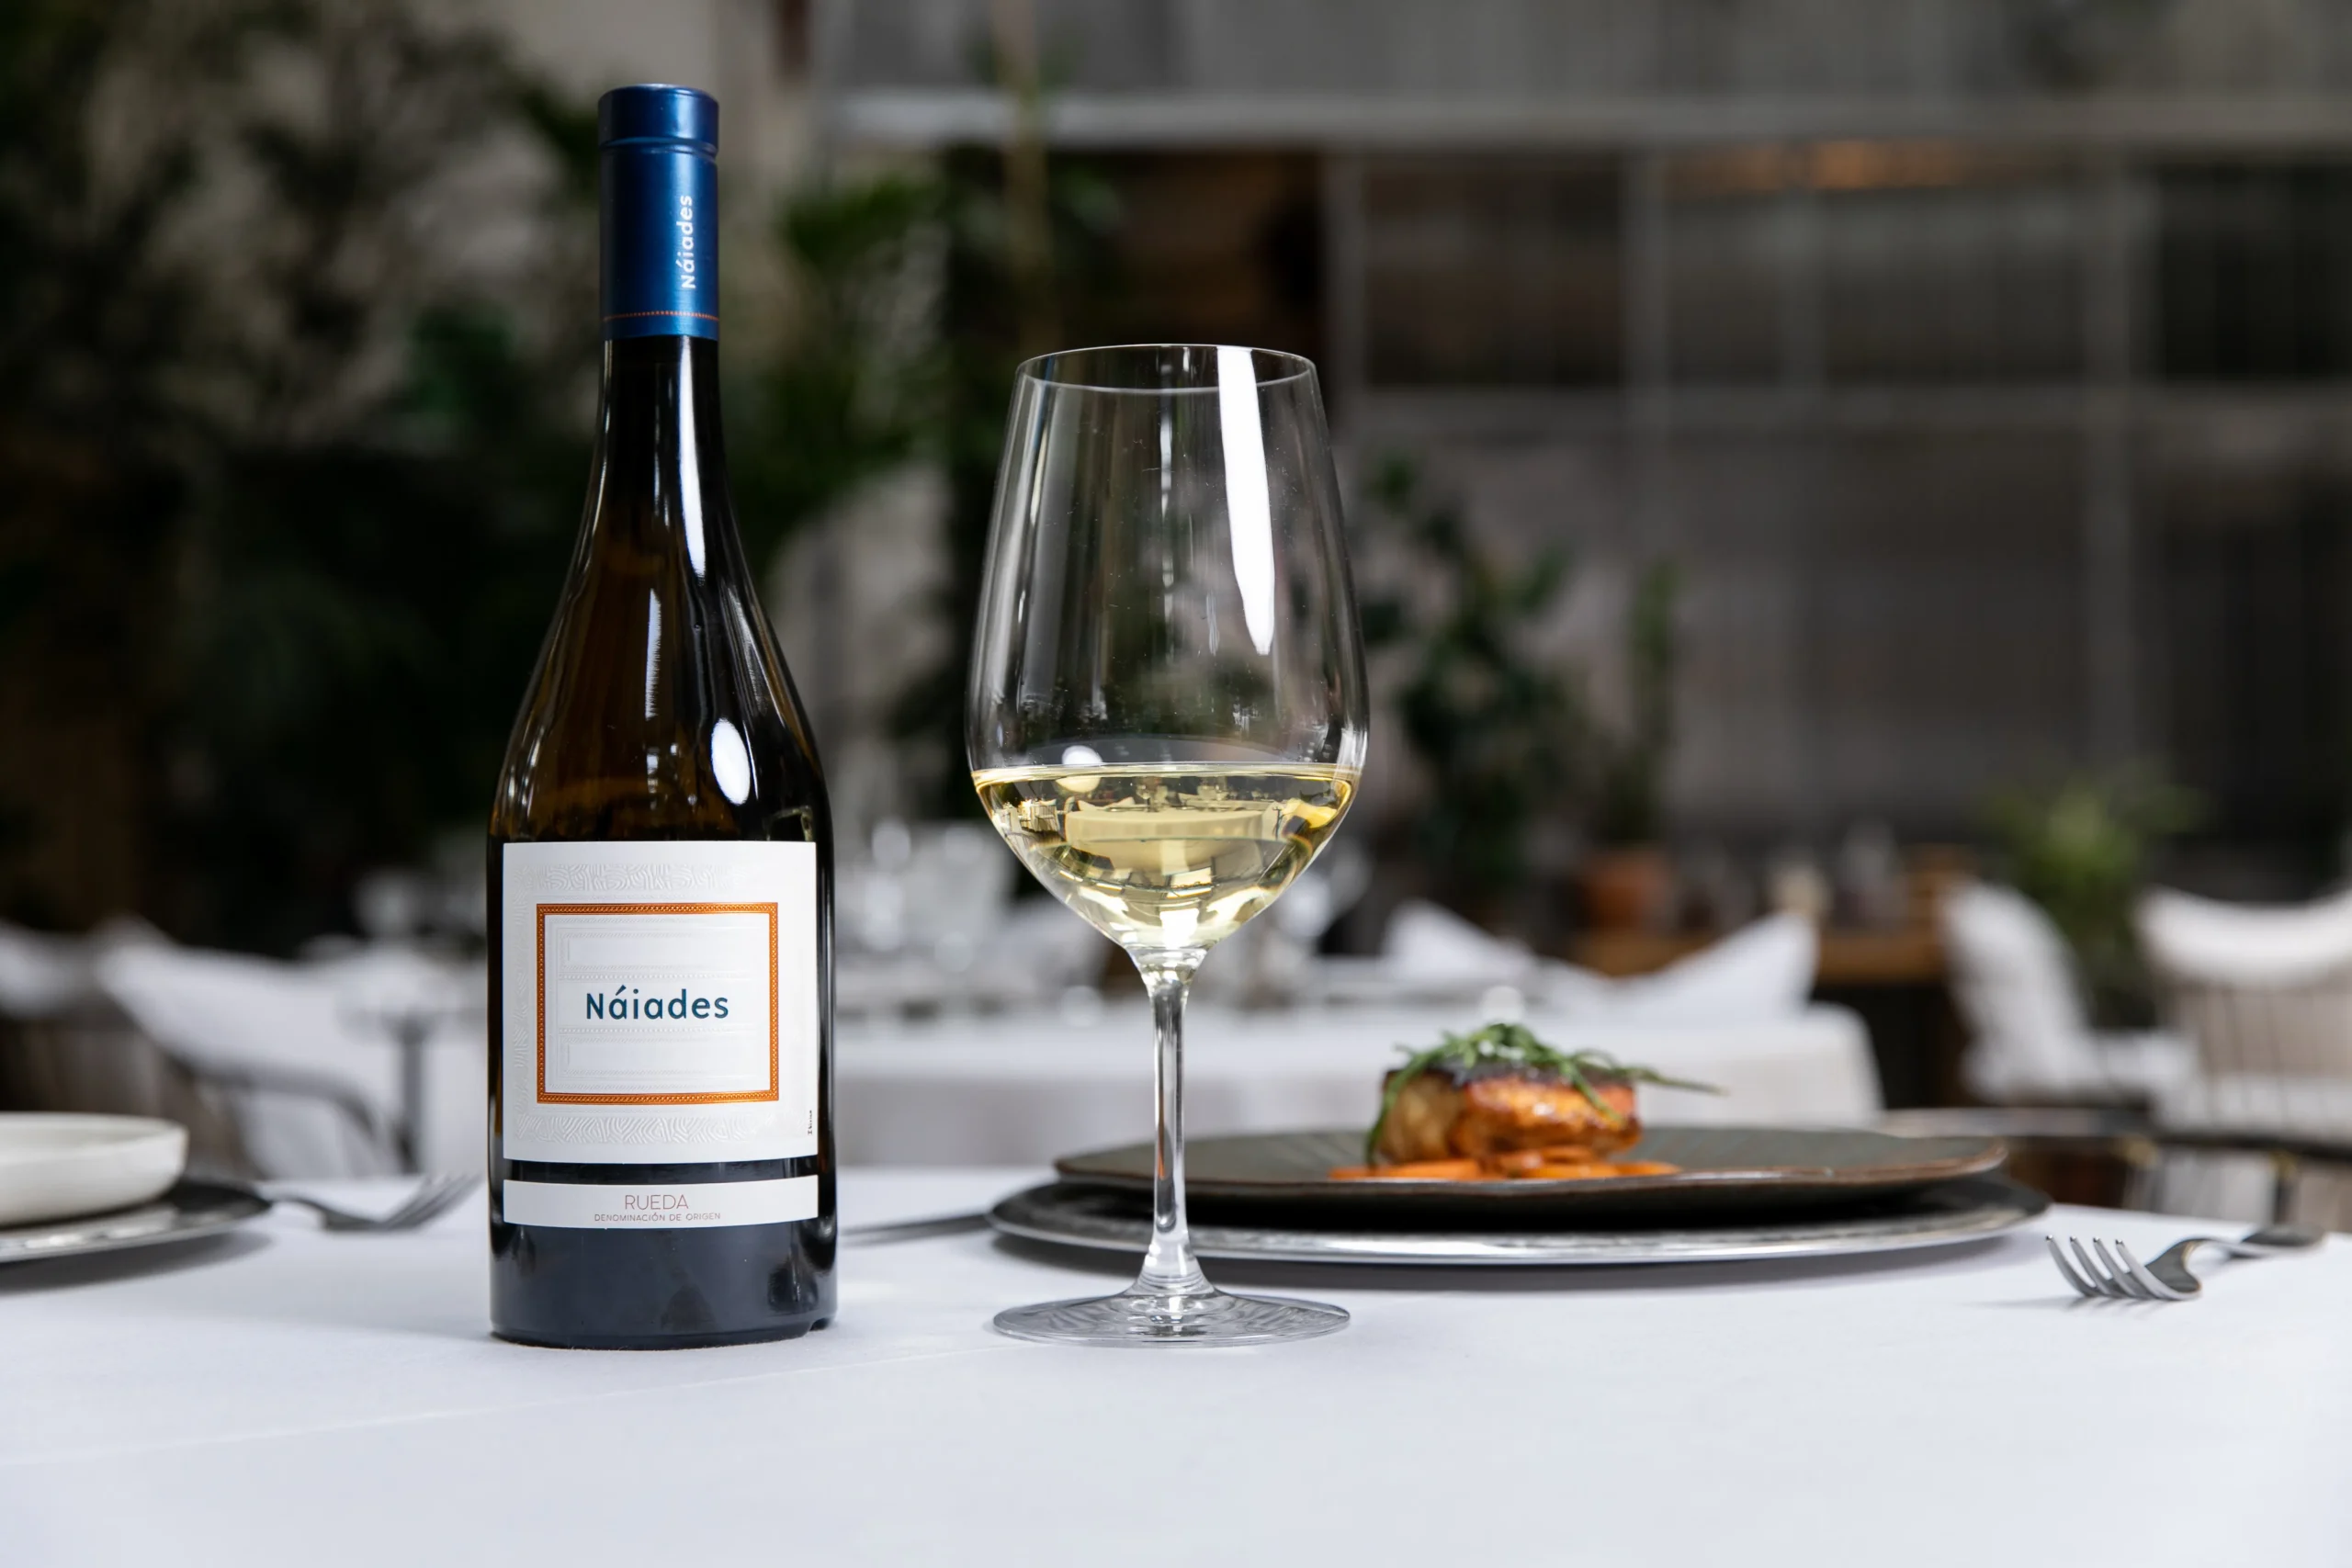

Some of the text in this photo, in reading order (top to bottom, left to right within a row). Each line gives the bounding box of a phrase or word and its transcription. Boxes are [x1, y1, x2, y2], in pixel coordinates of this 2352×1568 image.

[675, 195, 695, 289] Náiades
[585, 985, 729, 1020] Náiades
[625, 1194, 689, 1211] RUEDA
[594, 1212, 721, 1223] DENOMINACIÓN DE ORIGEN
